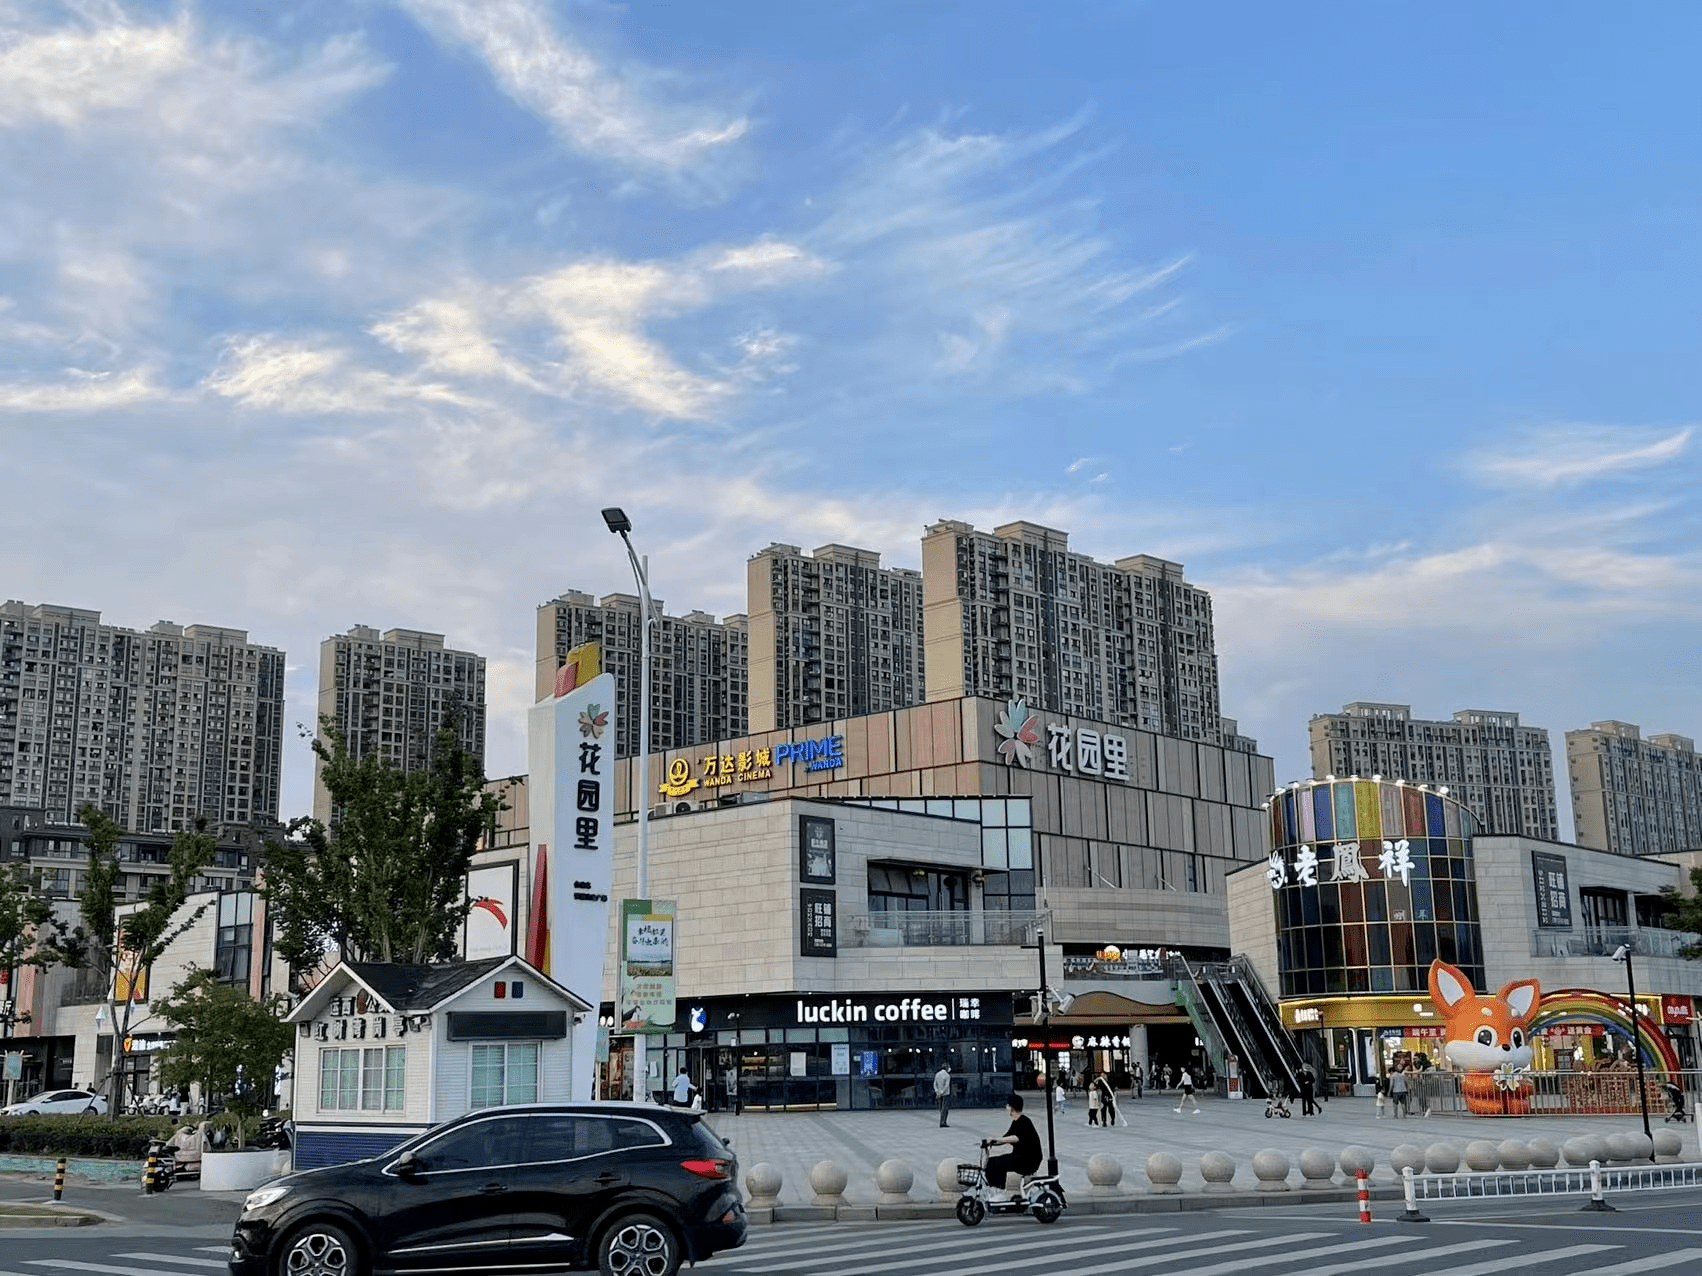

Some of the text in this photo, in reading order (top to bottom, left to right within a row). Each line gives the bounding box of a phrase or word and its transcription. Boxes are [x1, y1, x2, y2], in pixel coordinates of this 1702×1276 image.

[703, 747, 772, 776] 万达影城
[775, 735, 843, 766] PRIME
[1047, 722, 1130, 781] 花园里
[810, 757, 842, 770] WANDA
[703, 768, 772, 788] WANDA CINEMA
[573, 742, 601, 851] 花园里
[797, 998, 948, 1023] luckin coffee
[958, 997, 980, 1009] 瑞幸
[958, 1008, 980, 1020] 咖啡
